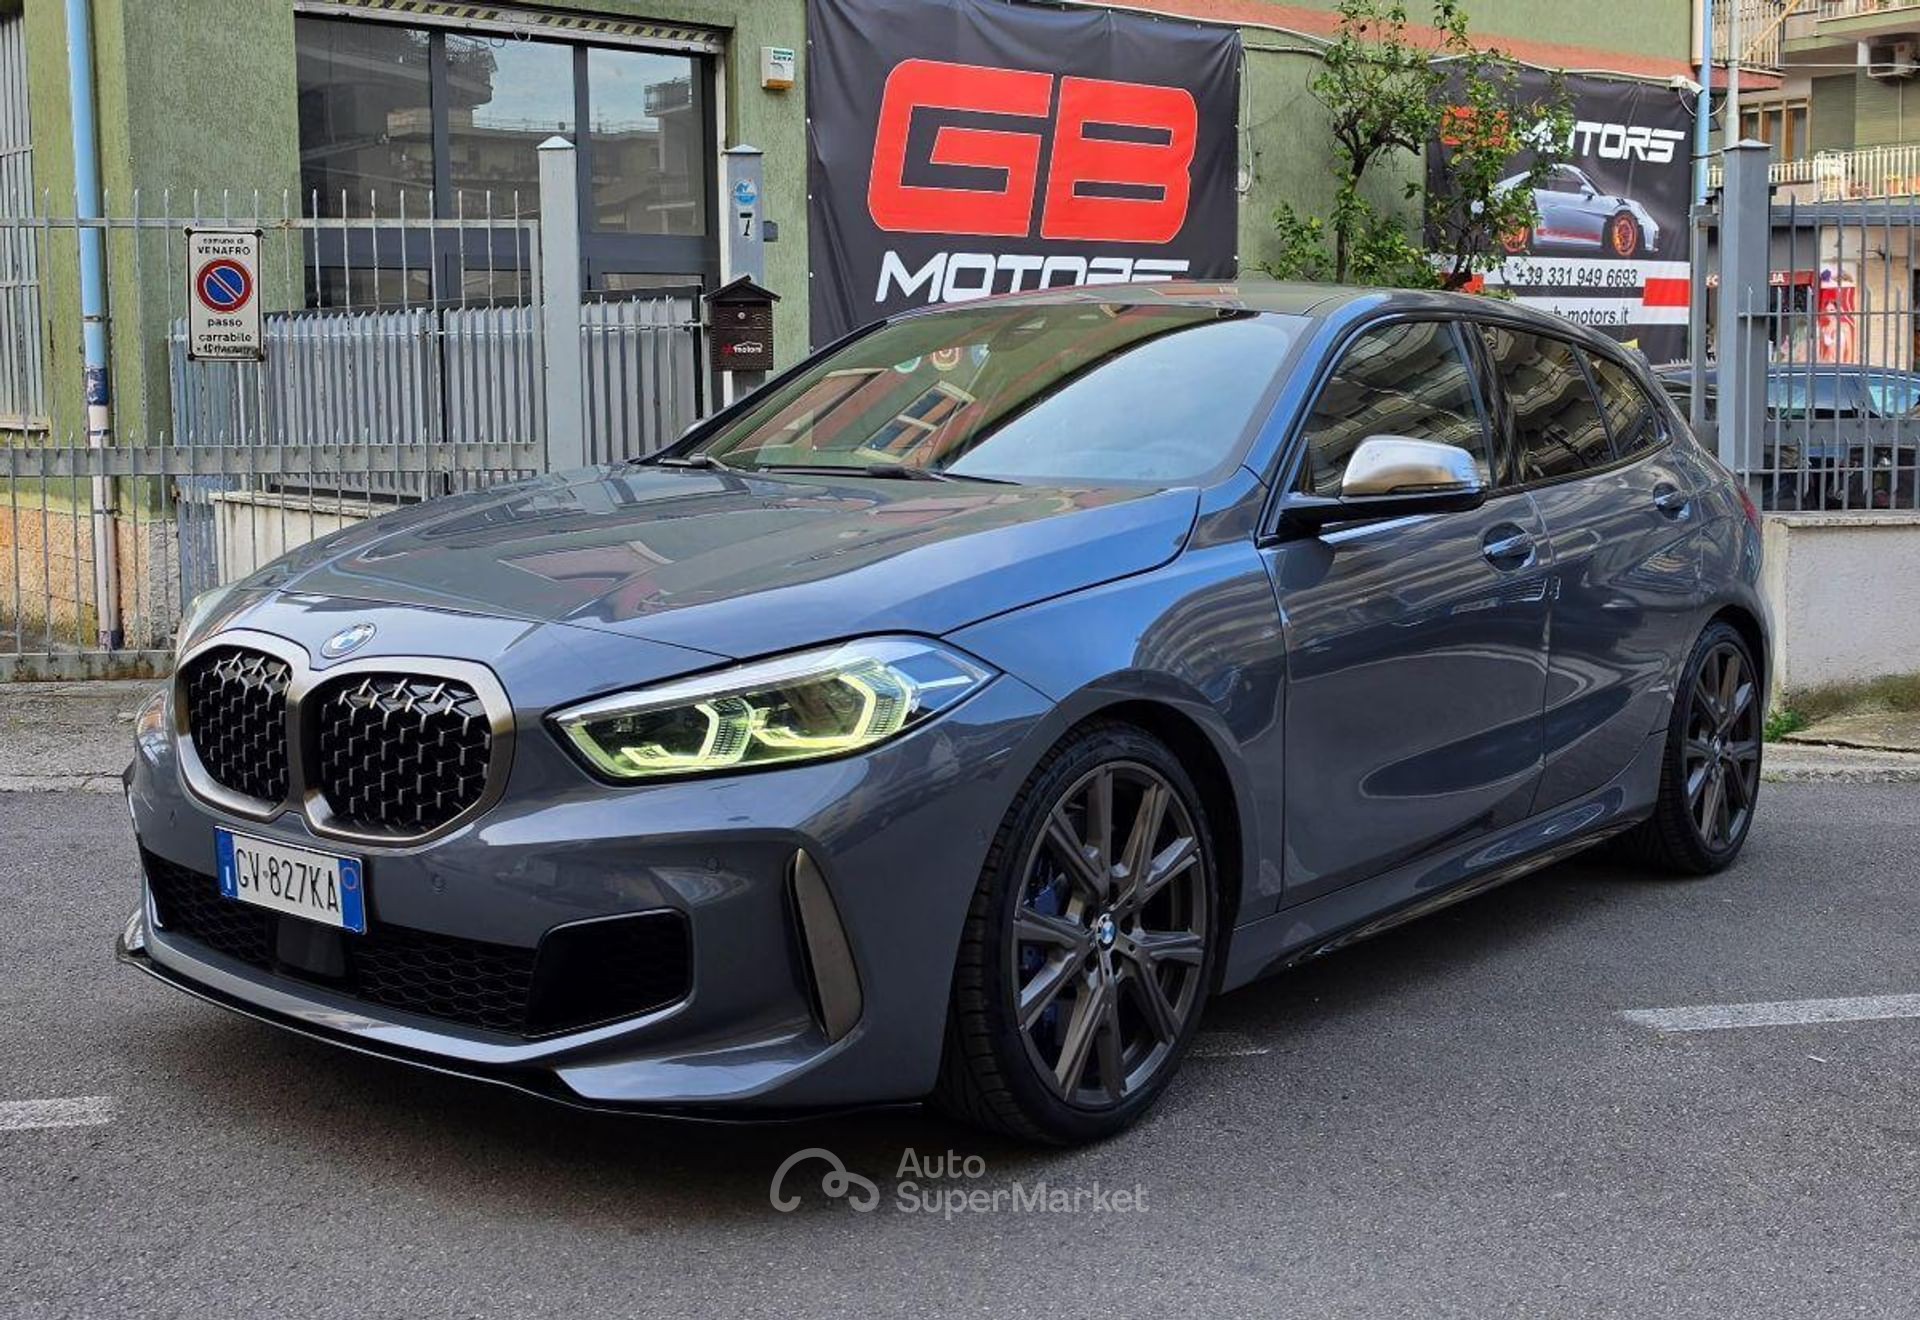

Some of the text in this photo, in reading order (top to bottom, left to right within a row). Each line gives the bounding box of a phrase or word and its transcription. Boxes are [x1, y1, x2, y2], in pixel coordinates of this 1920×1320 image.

[1517, 115, 1686, 163] MTORS
[867, 58, 1198, 244] GB
[198, 246, 251, 255] VENAFRO
[1516, 266, 1638, 288] +39 331 949 6693
[208, 318, 243, 328] passo
[198, 332, 252, 342] carrabile
